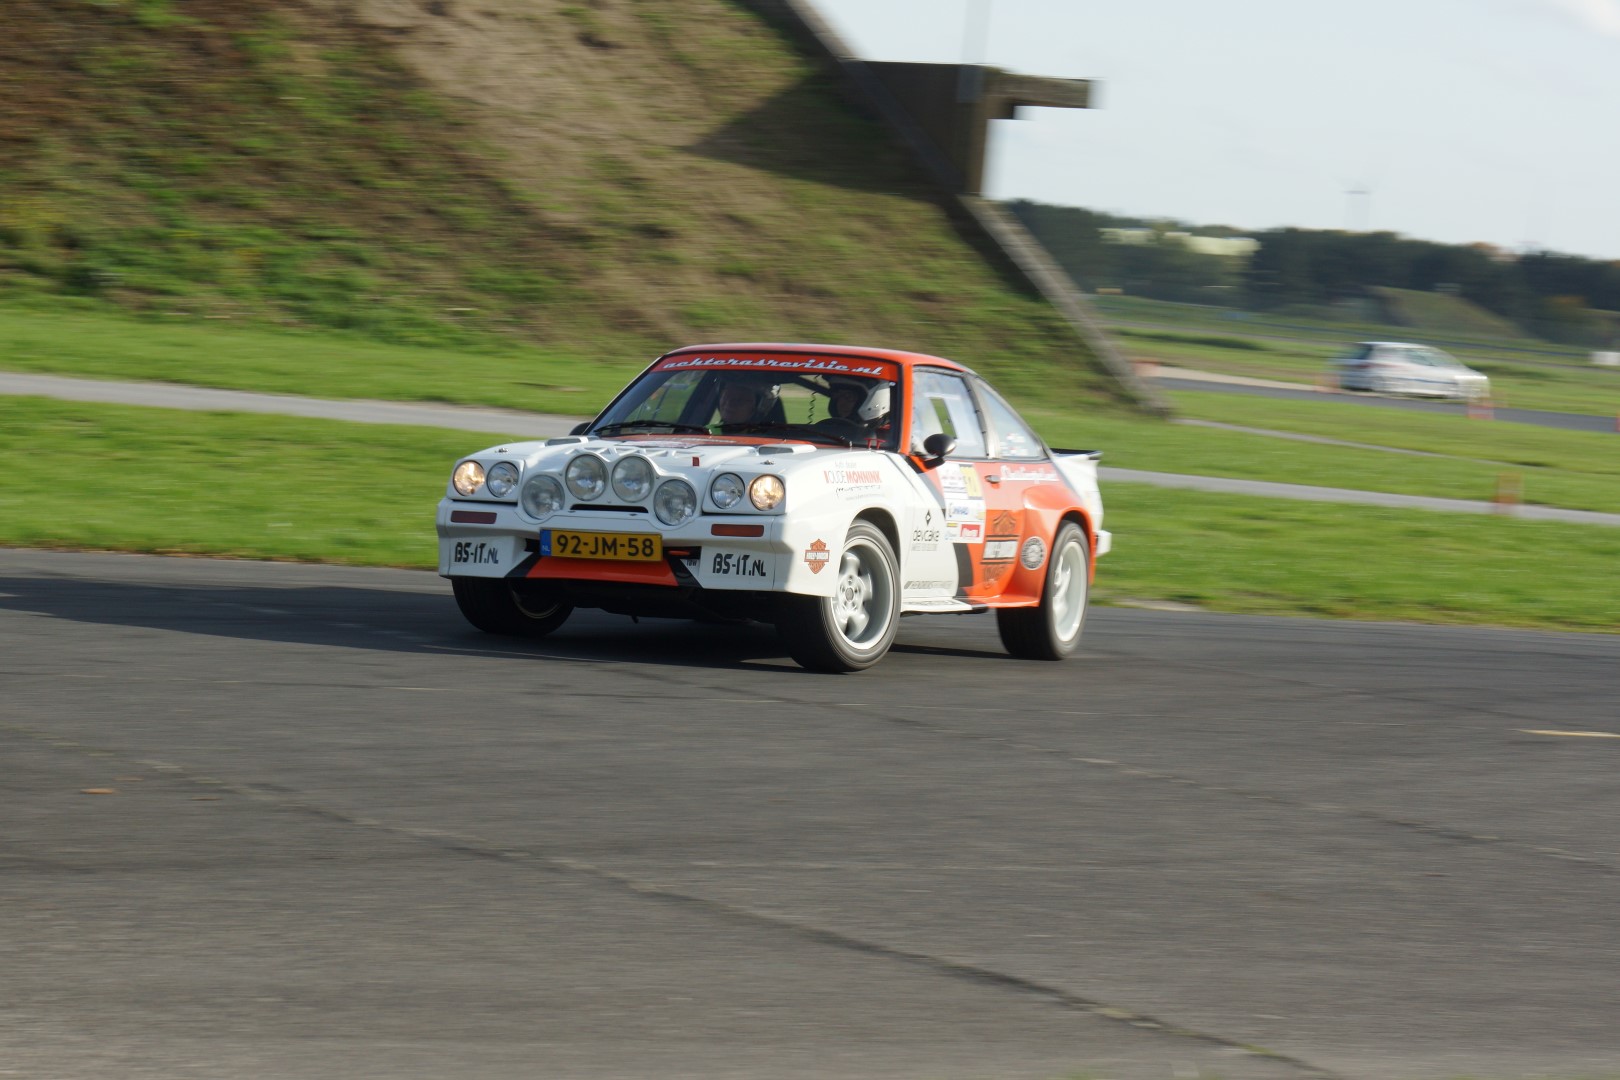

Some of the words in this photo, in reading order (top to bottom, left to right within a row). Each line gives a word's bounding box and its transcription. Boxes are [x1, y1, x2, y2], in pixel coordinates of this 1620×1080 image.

[662, 357, 884, 376] achterasrevisie.nl
[454, 541, 499, 564] BS-IT.NL
[556, 534, 654, 557] 92-JM-58
[712, 552, 767, 577] BS-IT.NL
